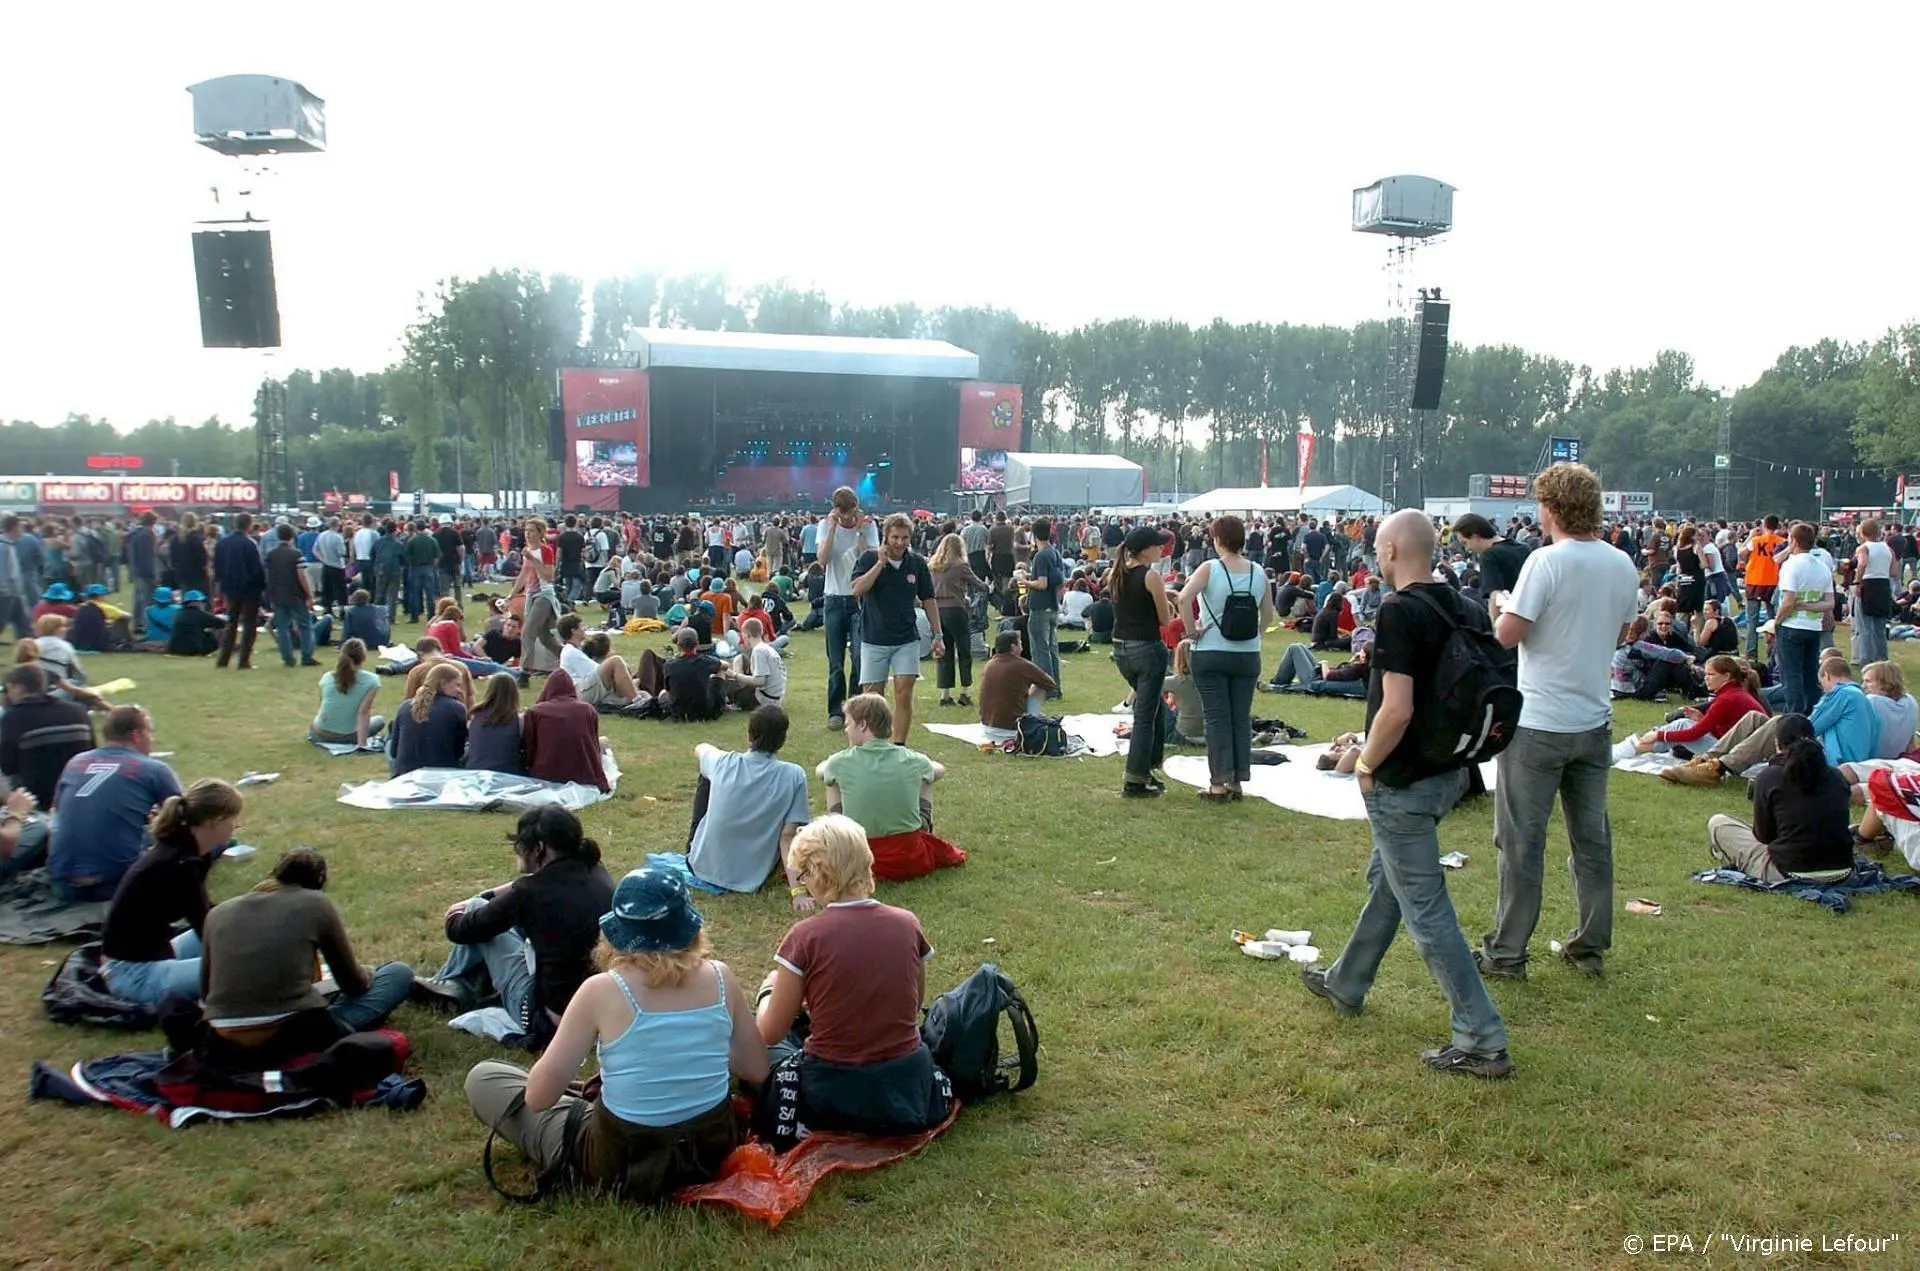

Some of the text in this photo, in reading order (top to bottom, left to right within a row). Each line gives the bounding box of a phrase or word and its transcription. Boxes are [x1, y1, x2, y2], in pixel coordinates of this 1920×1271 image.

[45, 484, 111, 501] HUMO
[121, 484, 186, 501] HUMO
[195, 484, 257, 501] HUMO
[75, 763, 121, 797] 7
